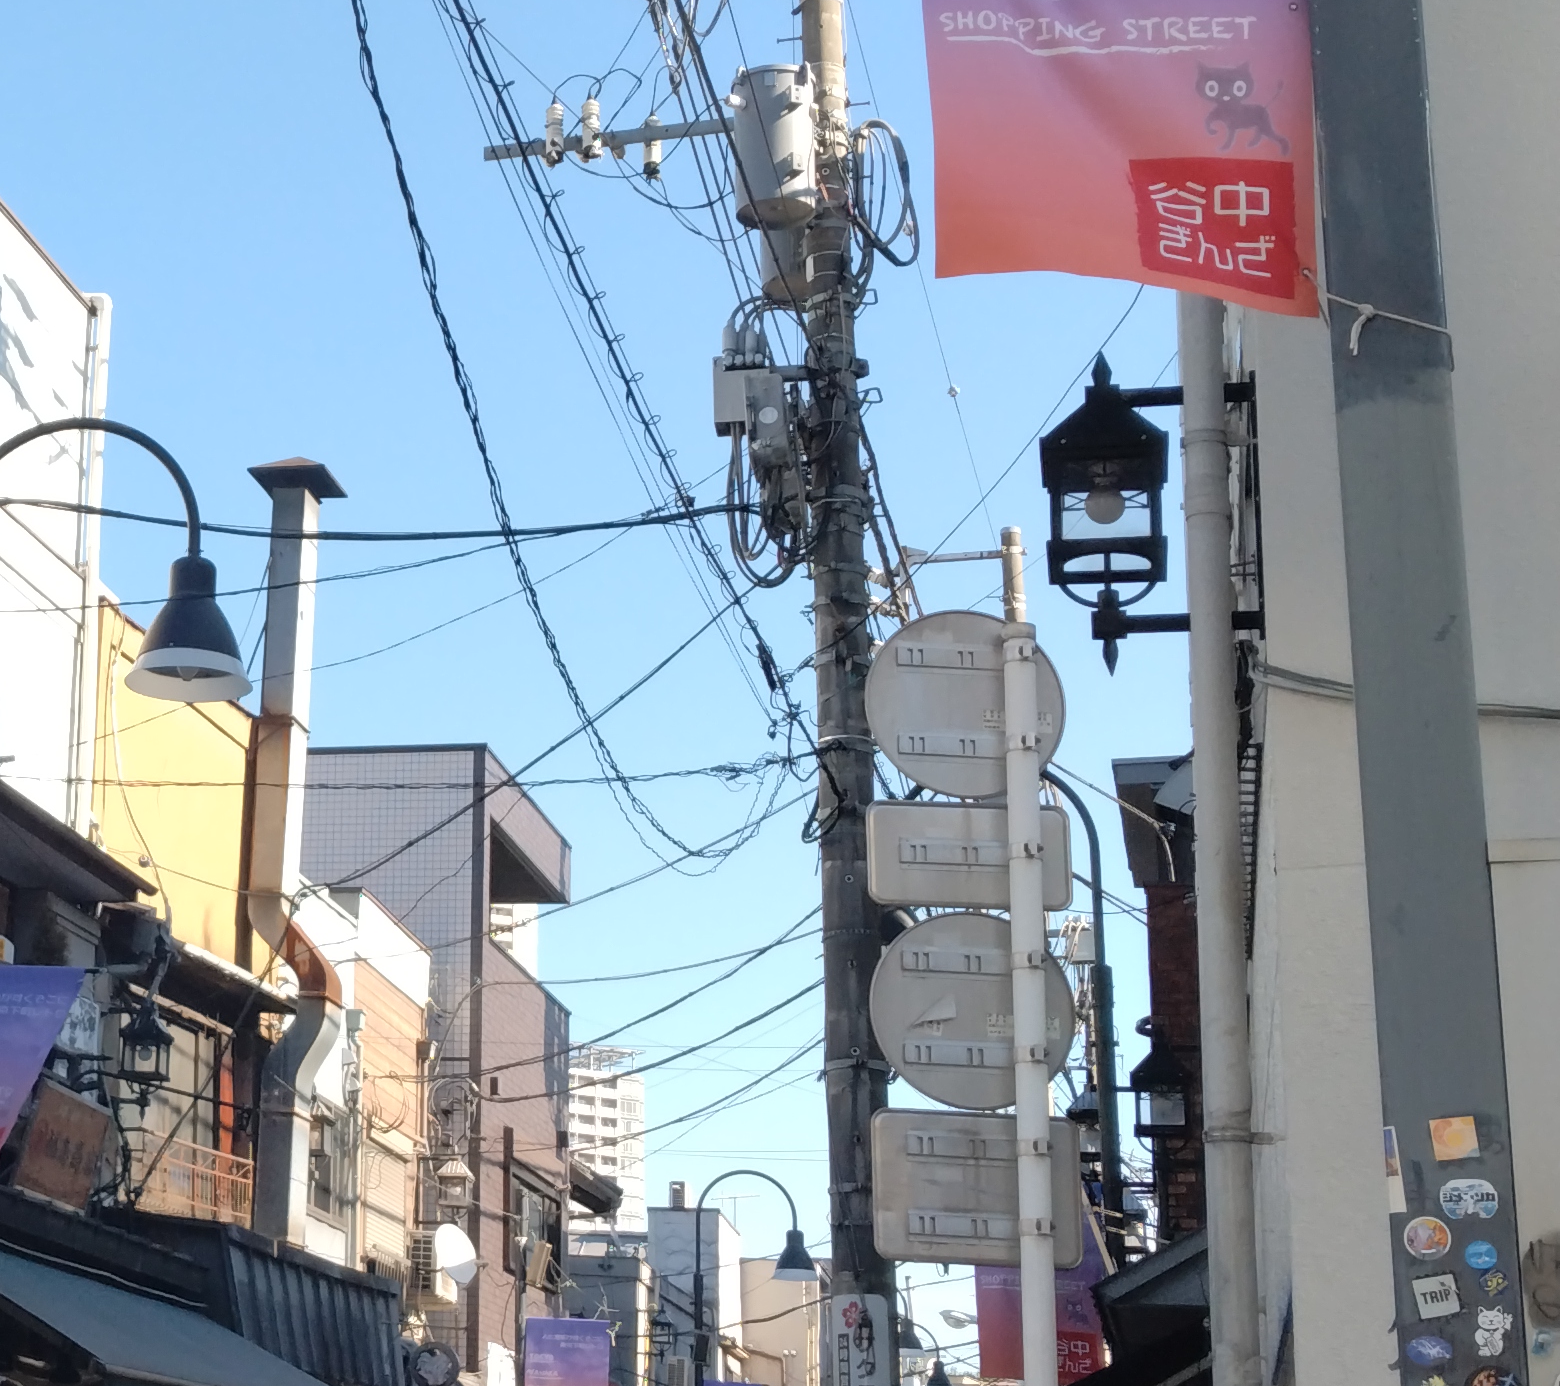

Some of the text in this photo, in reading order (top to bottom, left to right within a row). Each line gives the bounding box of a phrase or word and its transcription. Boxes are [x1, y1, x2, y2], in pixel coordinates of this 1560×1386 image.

[939, 11, 1257, 42] SHOPPING STREET
[1148, 180, 1271, 227] 谷中
[1159, 223, 1276, 279] ぎんざ
[1420, 1287, 1452, 1306] TRIP
